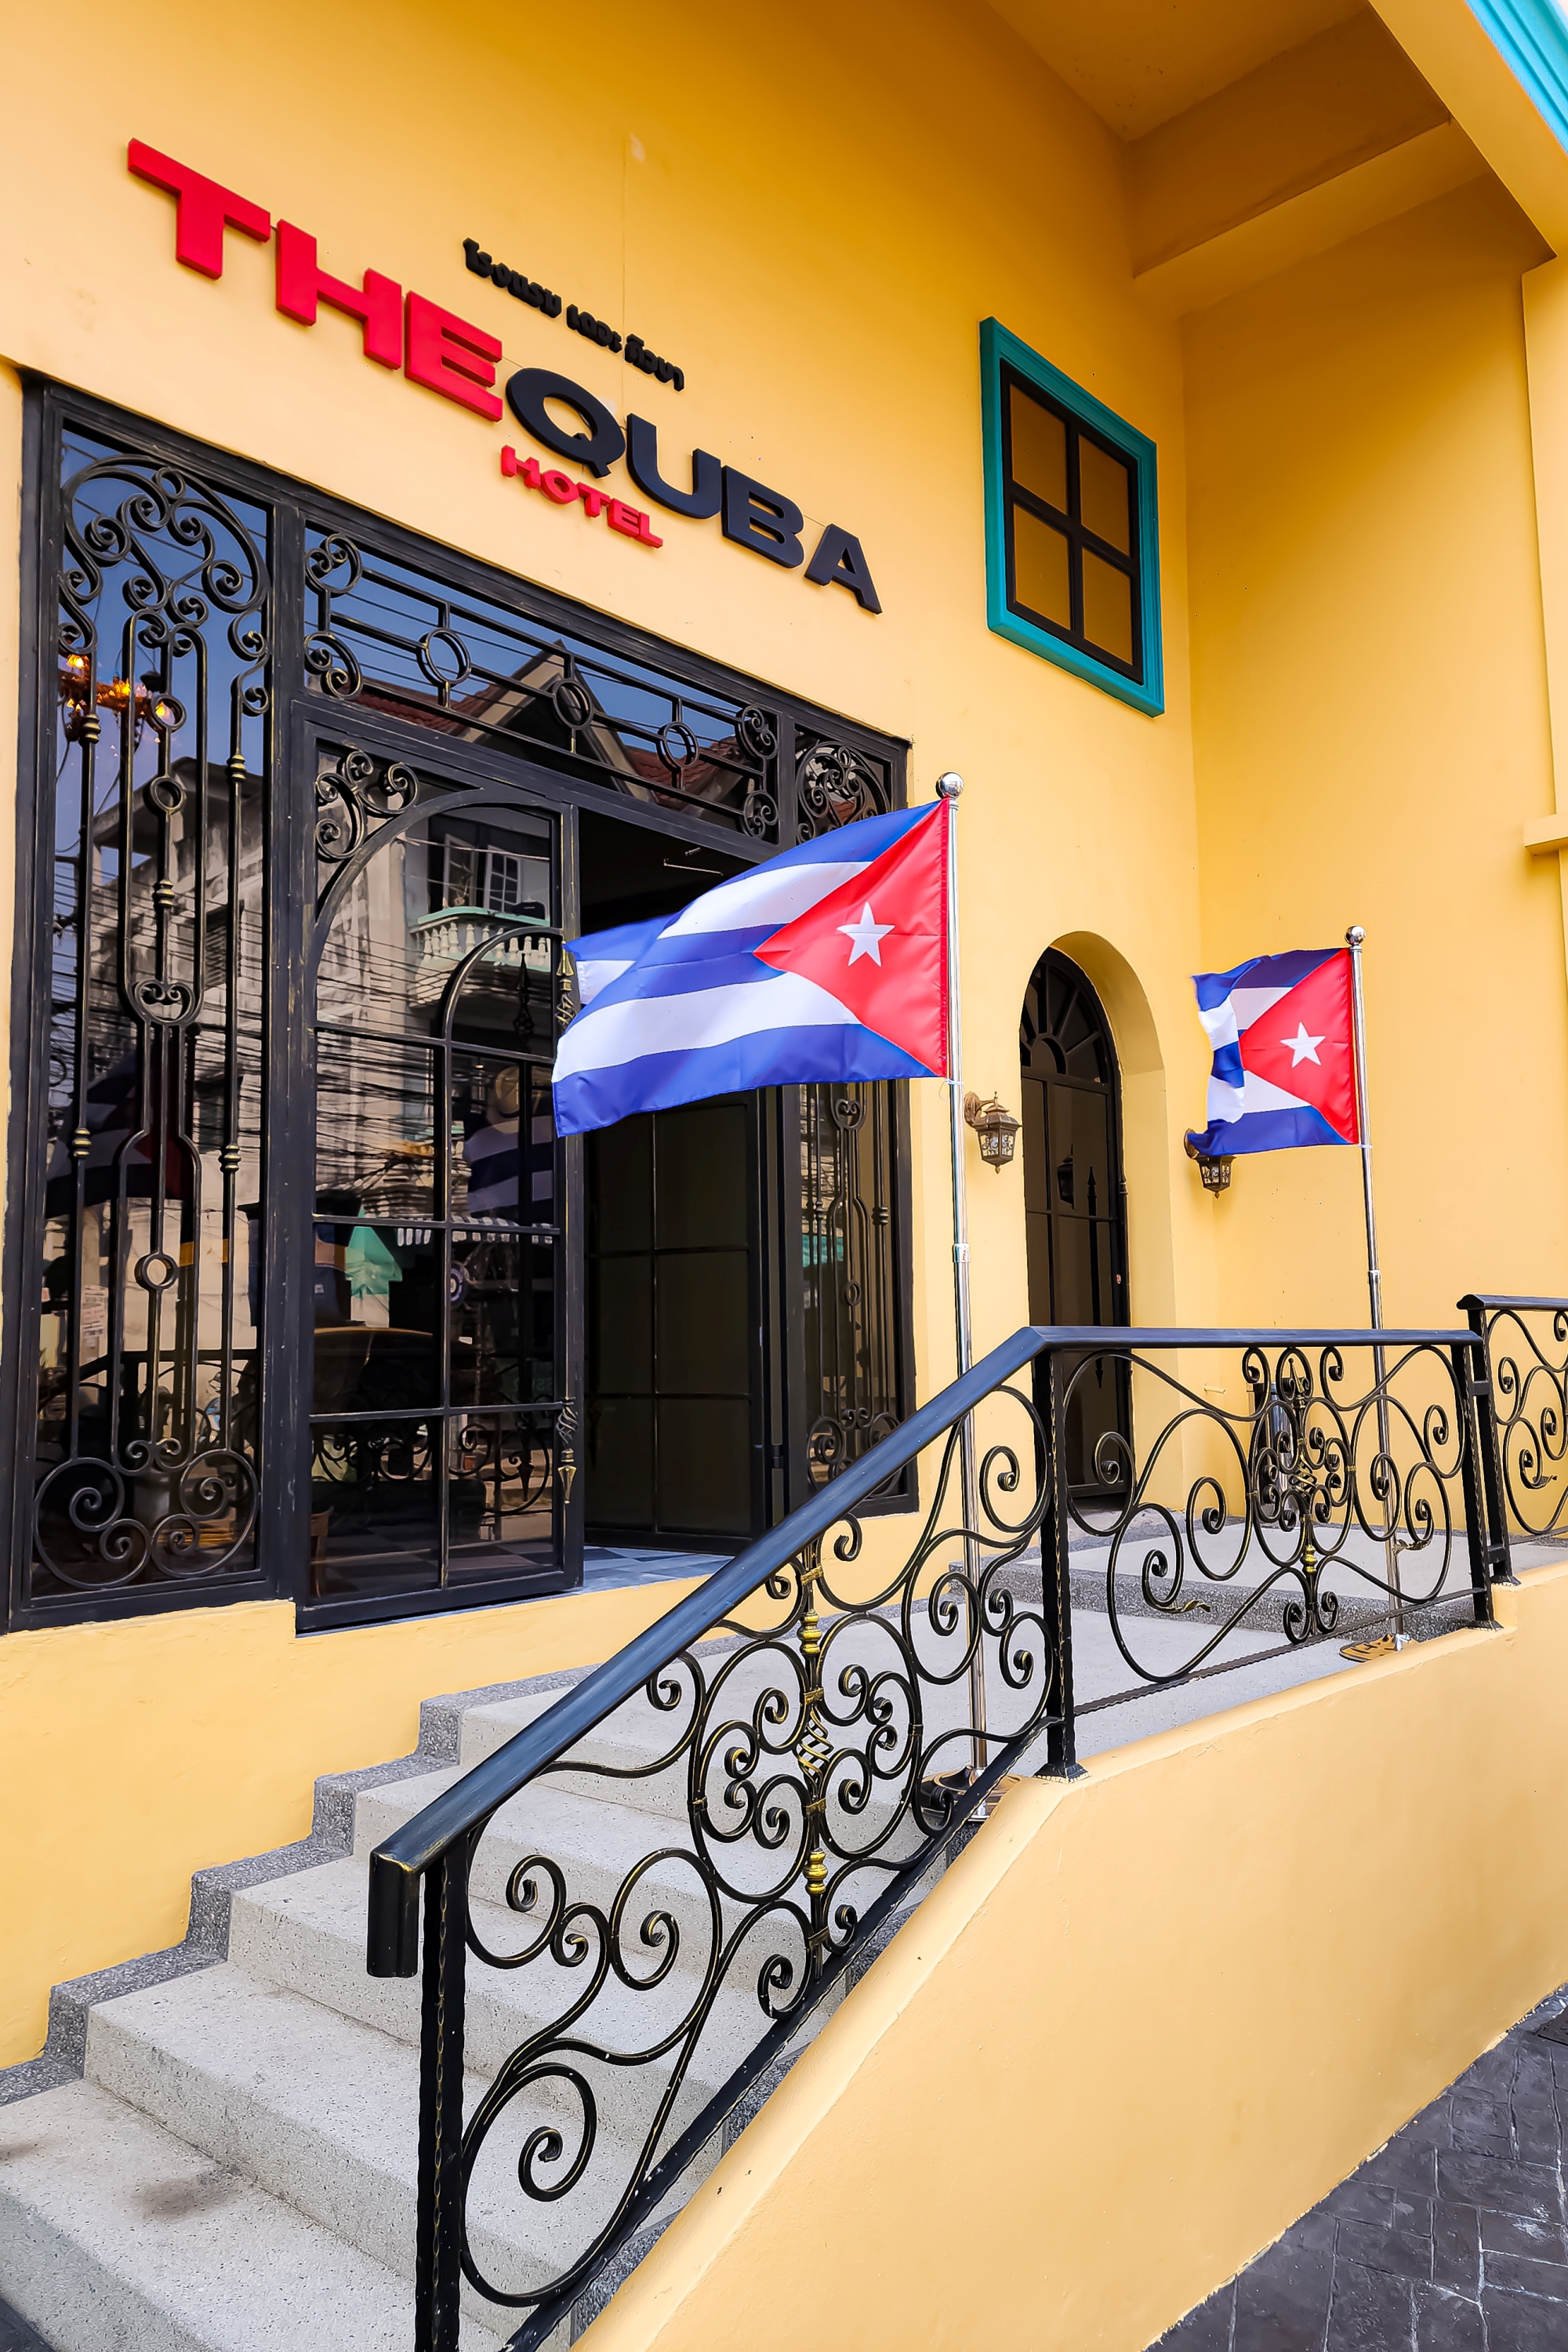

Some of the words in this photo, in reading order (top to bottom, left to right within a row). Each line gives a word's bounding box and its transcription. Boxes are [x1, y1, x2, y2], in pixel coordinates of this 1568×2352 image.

[463, 238, 562, 319] โรงแรม
[566, 304, 622, 354] เดอะ
[128, 138, 503, 423] THE
[506, 368, 883, 615] QUBA
[500, 445, 663, 549] HOTEL
